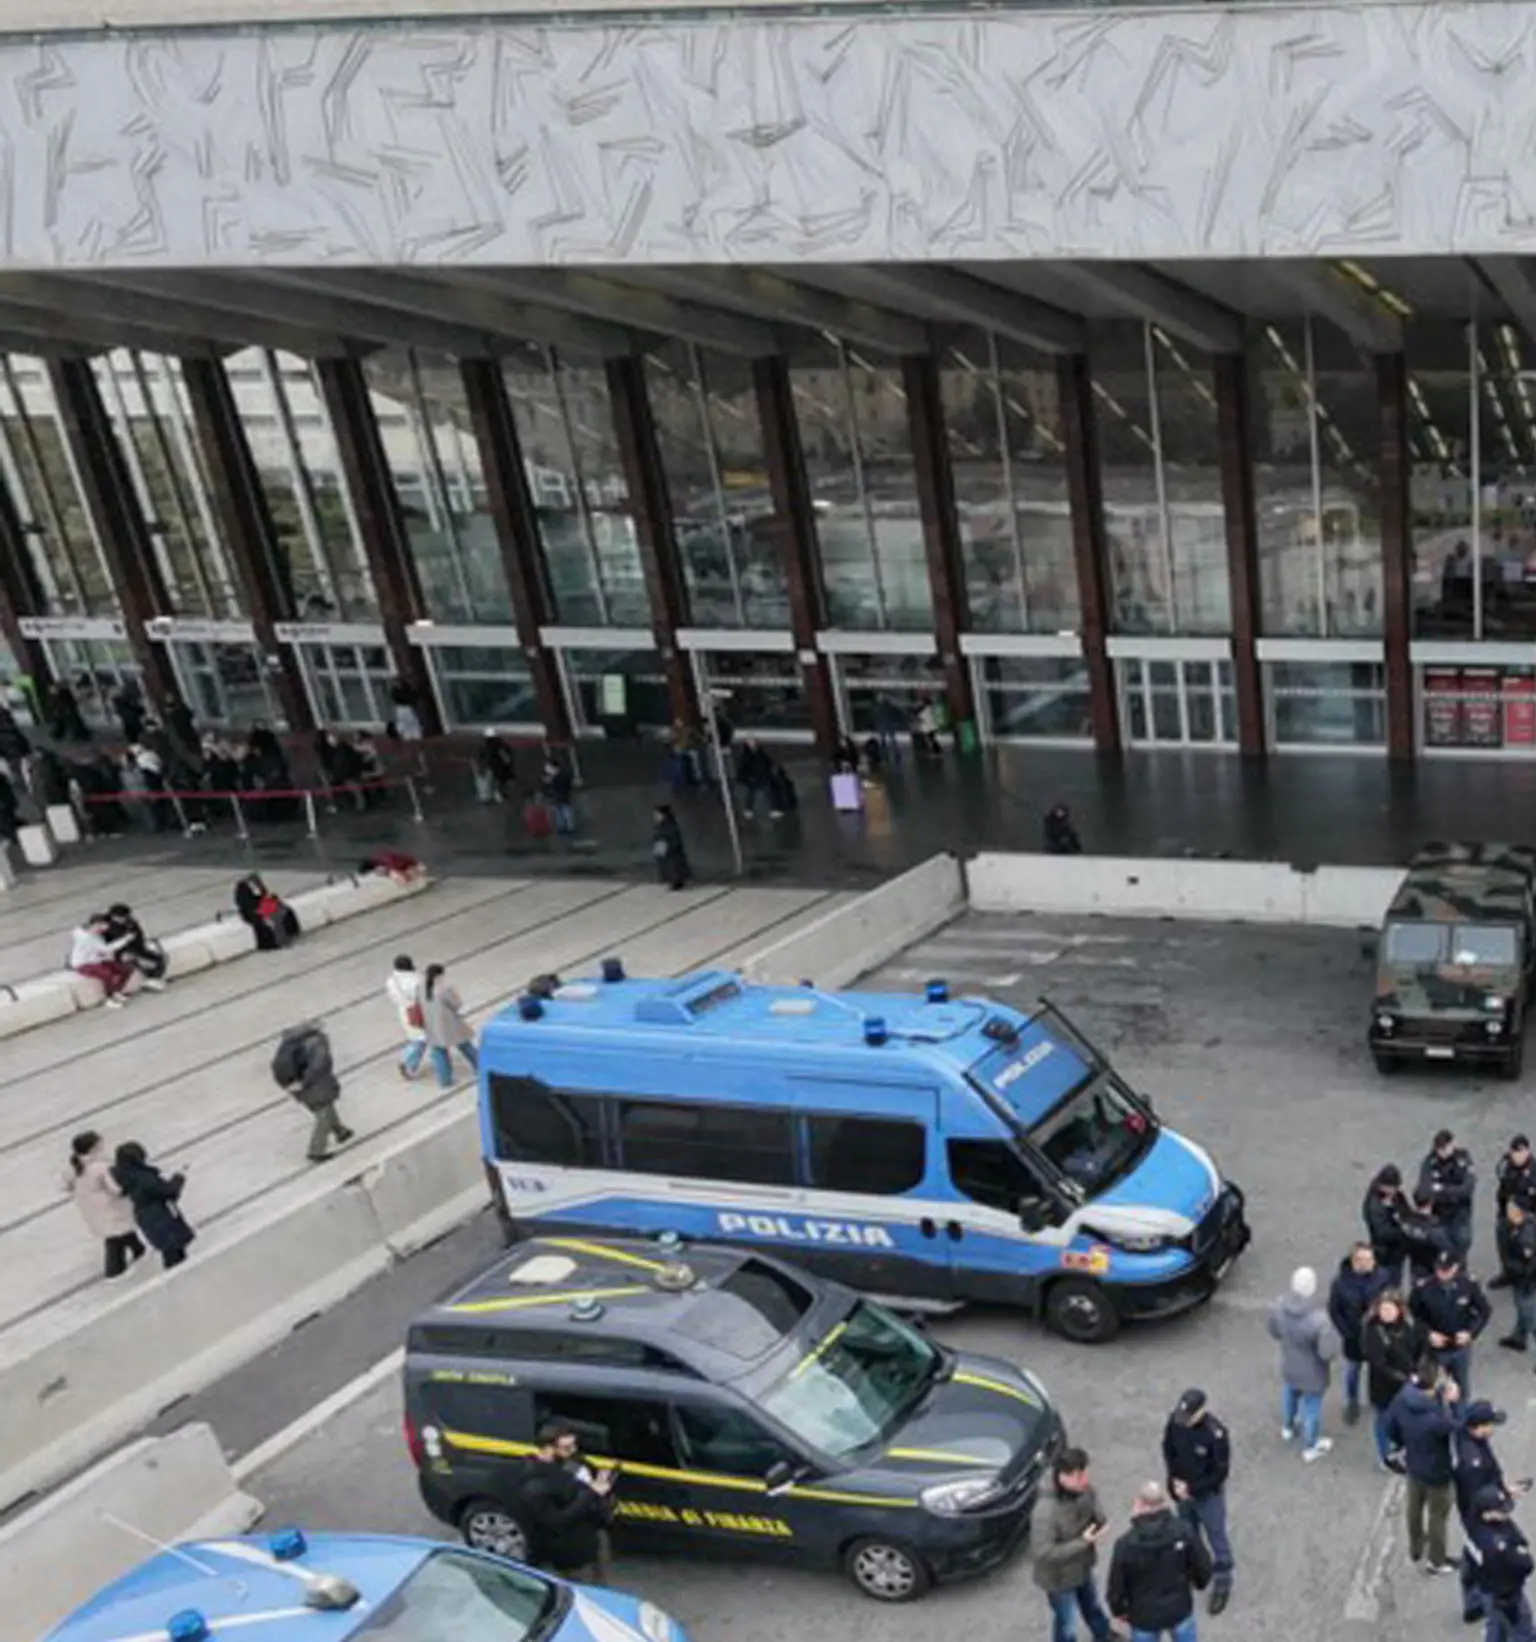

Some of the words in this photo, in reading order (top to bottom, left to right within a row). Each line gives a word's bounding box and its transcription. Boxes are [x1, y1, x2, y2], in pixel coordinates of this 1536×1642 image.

[993, 1041, 1053, 1088] POLIZIA
[717, 1212, 895, 1247] POLIZIA
[613, 1501, 679, 1521] ARDIA
[703, 1510, 793, 1537] FINANZA
